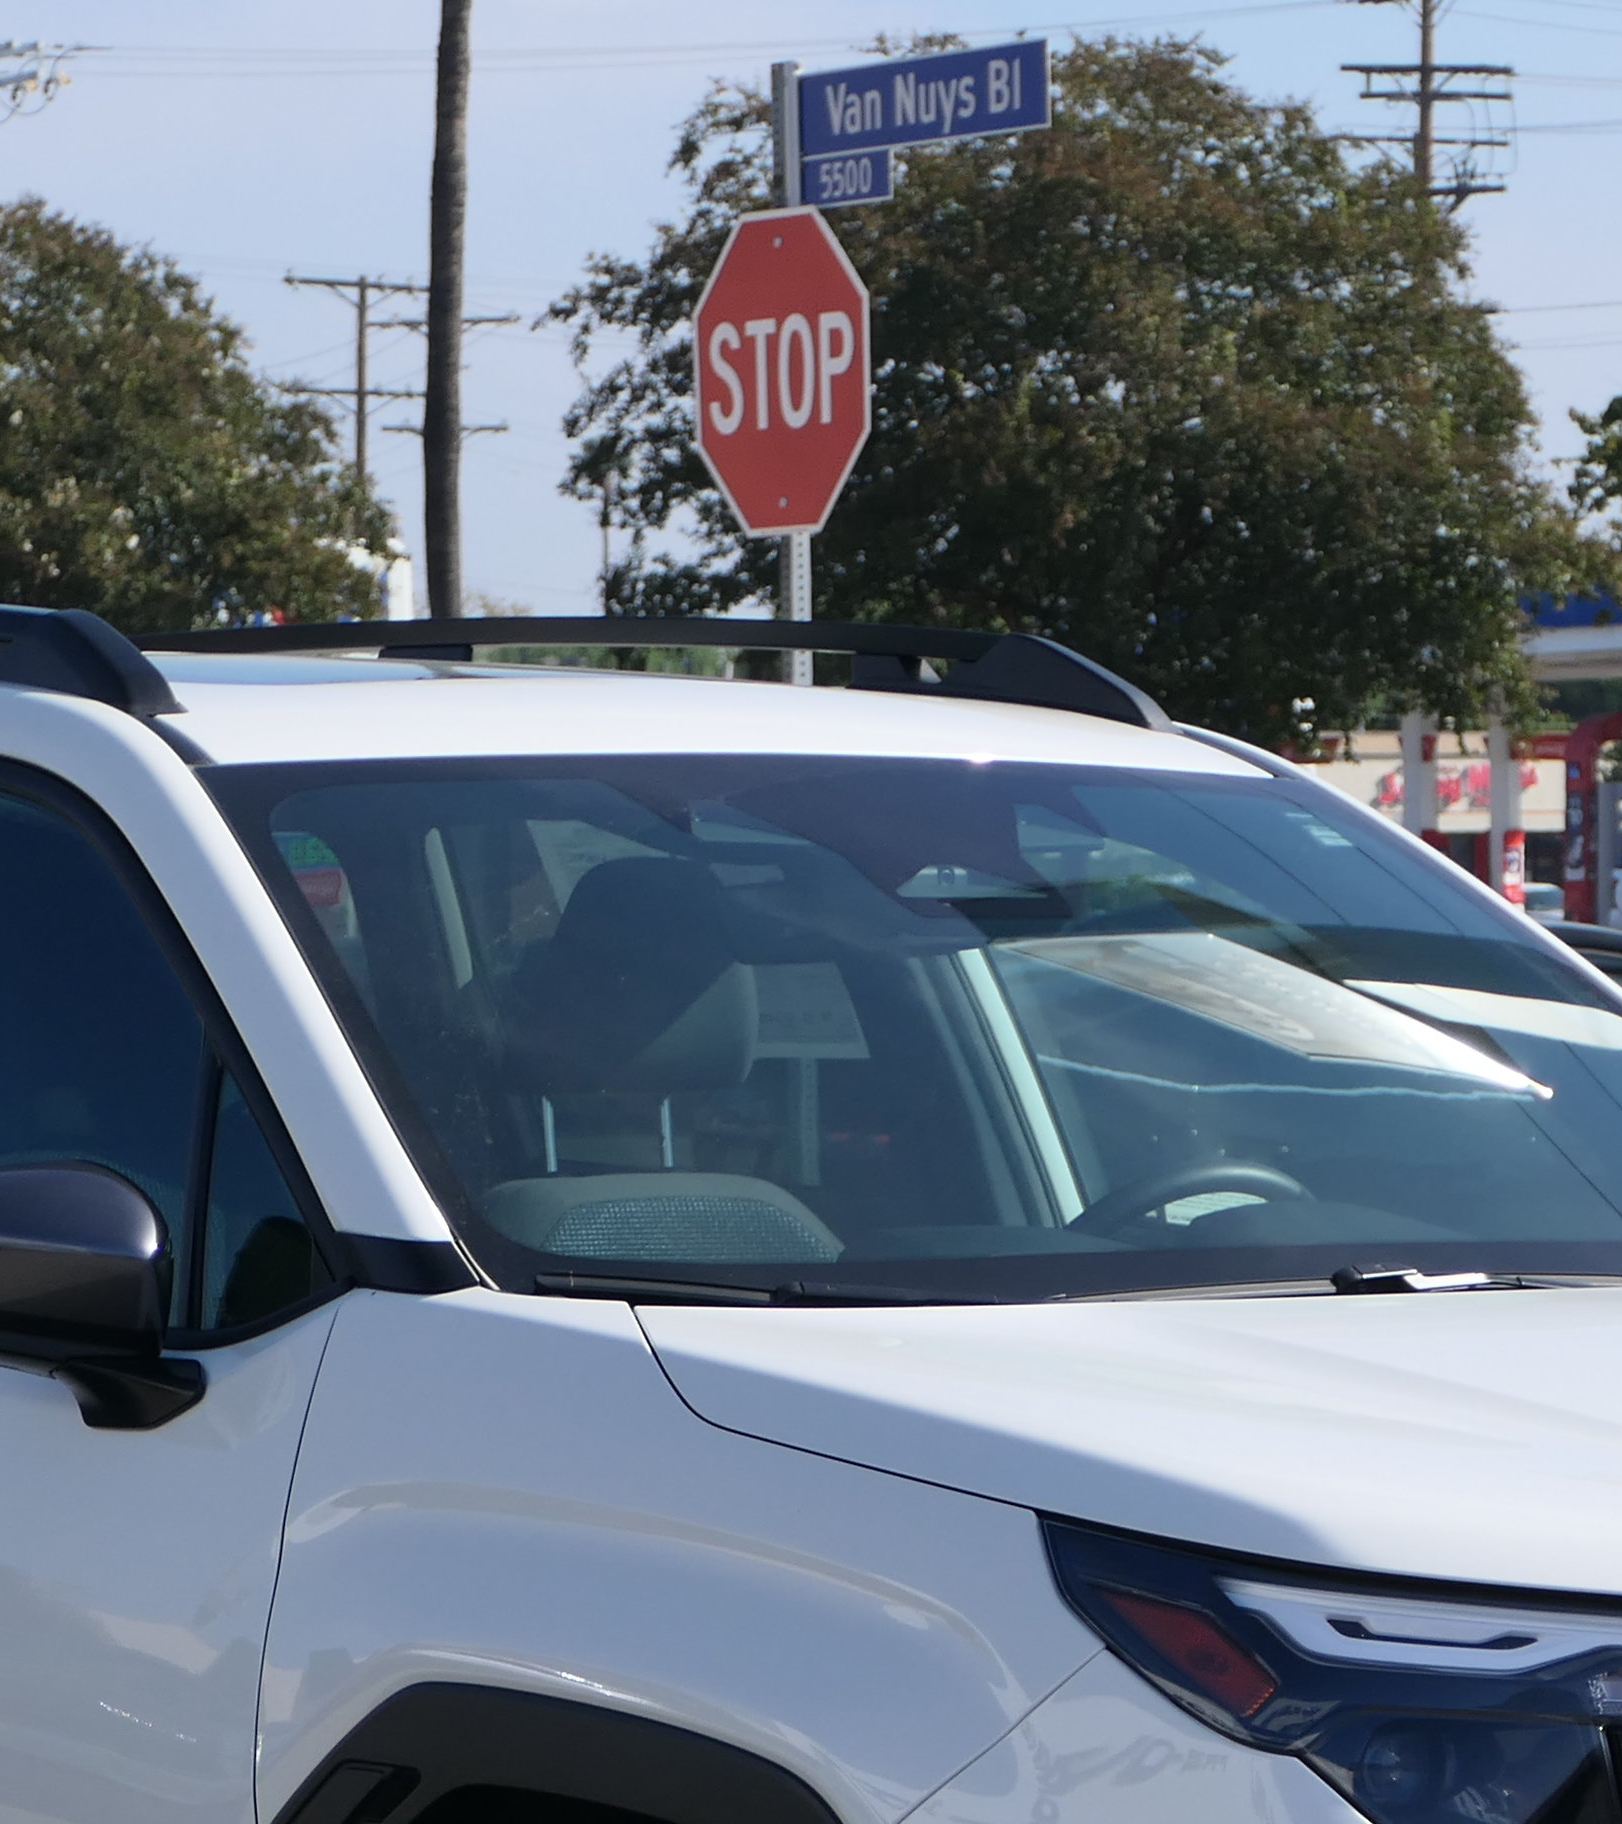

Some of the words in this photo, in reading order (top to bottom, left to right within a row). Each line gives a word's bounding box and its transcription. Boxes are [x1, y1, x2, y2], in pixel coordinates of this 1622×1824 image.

[827, 82, 882, 136] Van
[894, 71, 976, 135] Nuys
[987, 57, 1021, 114] Bl
[819, 157, 873, 199] 5500
[709, 311, 855, 436] STOP
